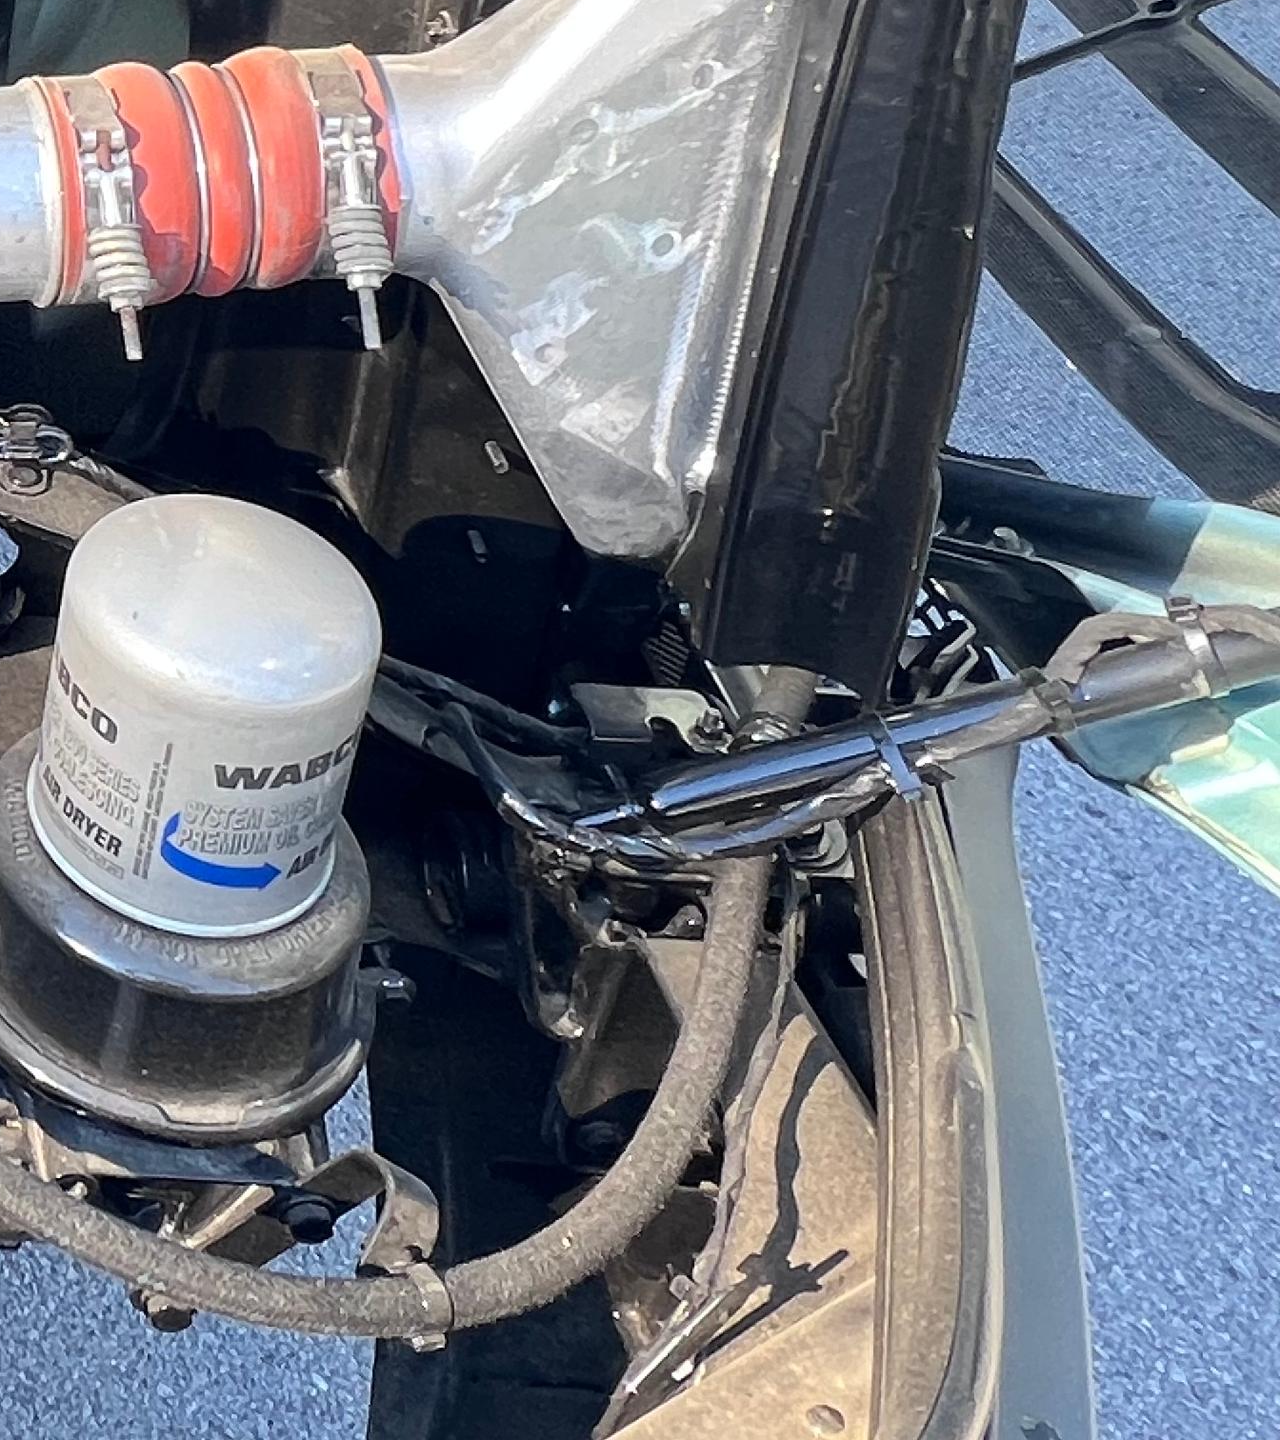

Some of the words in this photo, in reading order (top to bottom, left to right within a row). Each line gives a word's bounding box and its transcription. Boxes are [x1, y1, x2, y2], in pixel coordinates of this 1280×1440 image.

[63, 794, 122, 857] DRYER
[185, 801, 264, 830] SYSTEM
[179, 828, 272, 856] PREMIUM
